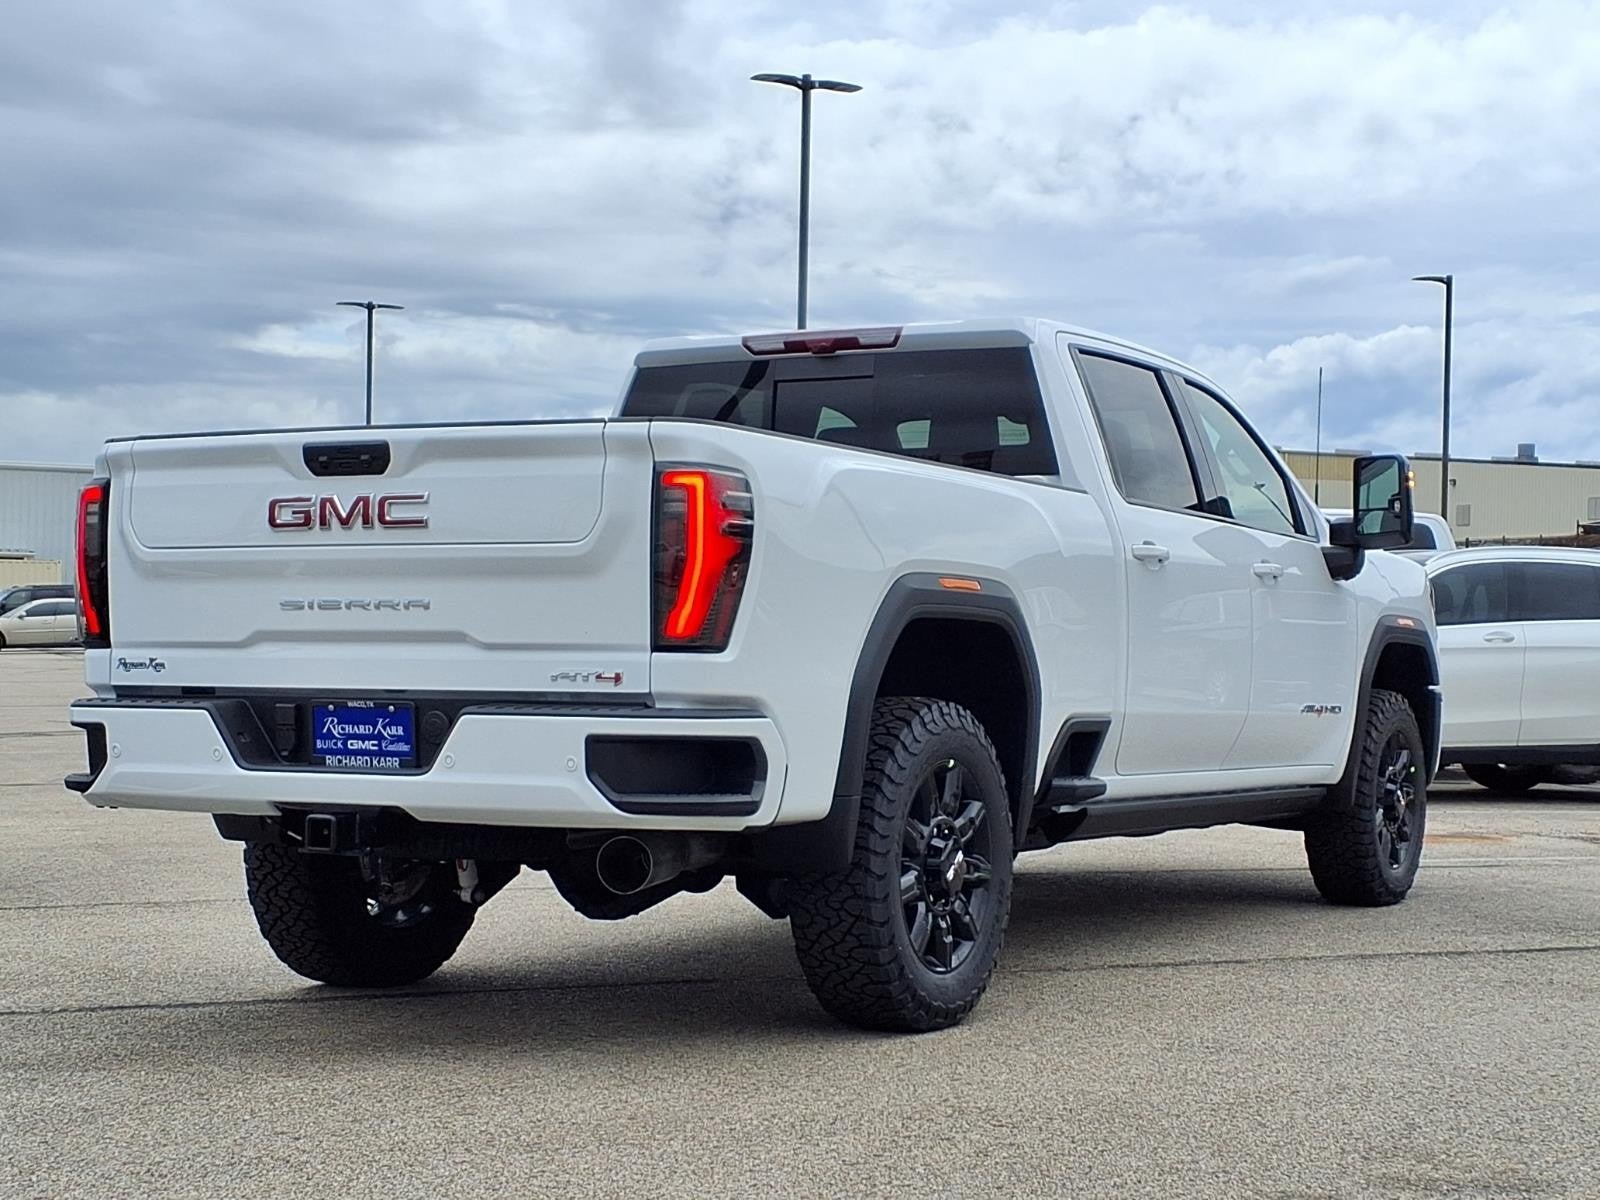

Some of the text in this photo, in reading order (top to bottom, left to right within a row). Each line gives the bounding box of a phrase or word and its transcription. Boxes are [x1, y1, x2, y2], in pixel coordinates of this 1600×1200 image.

[268, 491, 430, 532] GMC
[279, 598, 431, 611] SIERRA
[550, 671, 624, 687] AT4
[316, 738, 344, 750] BUICK
[347, 739, 379, 750] GMC
[325, 754, 400, 769] RICHARD KARR
